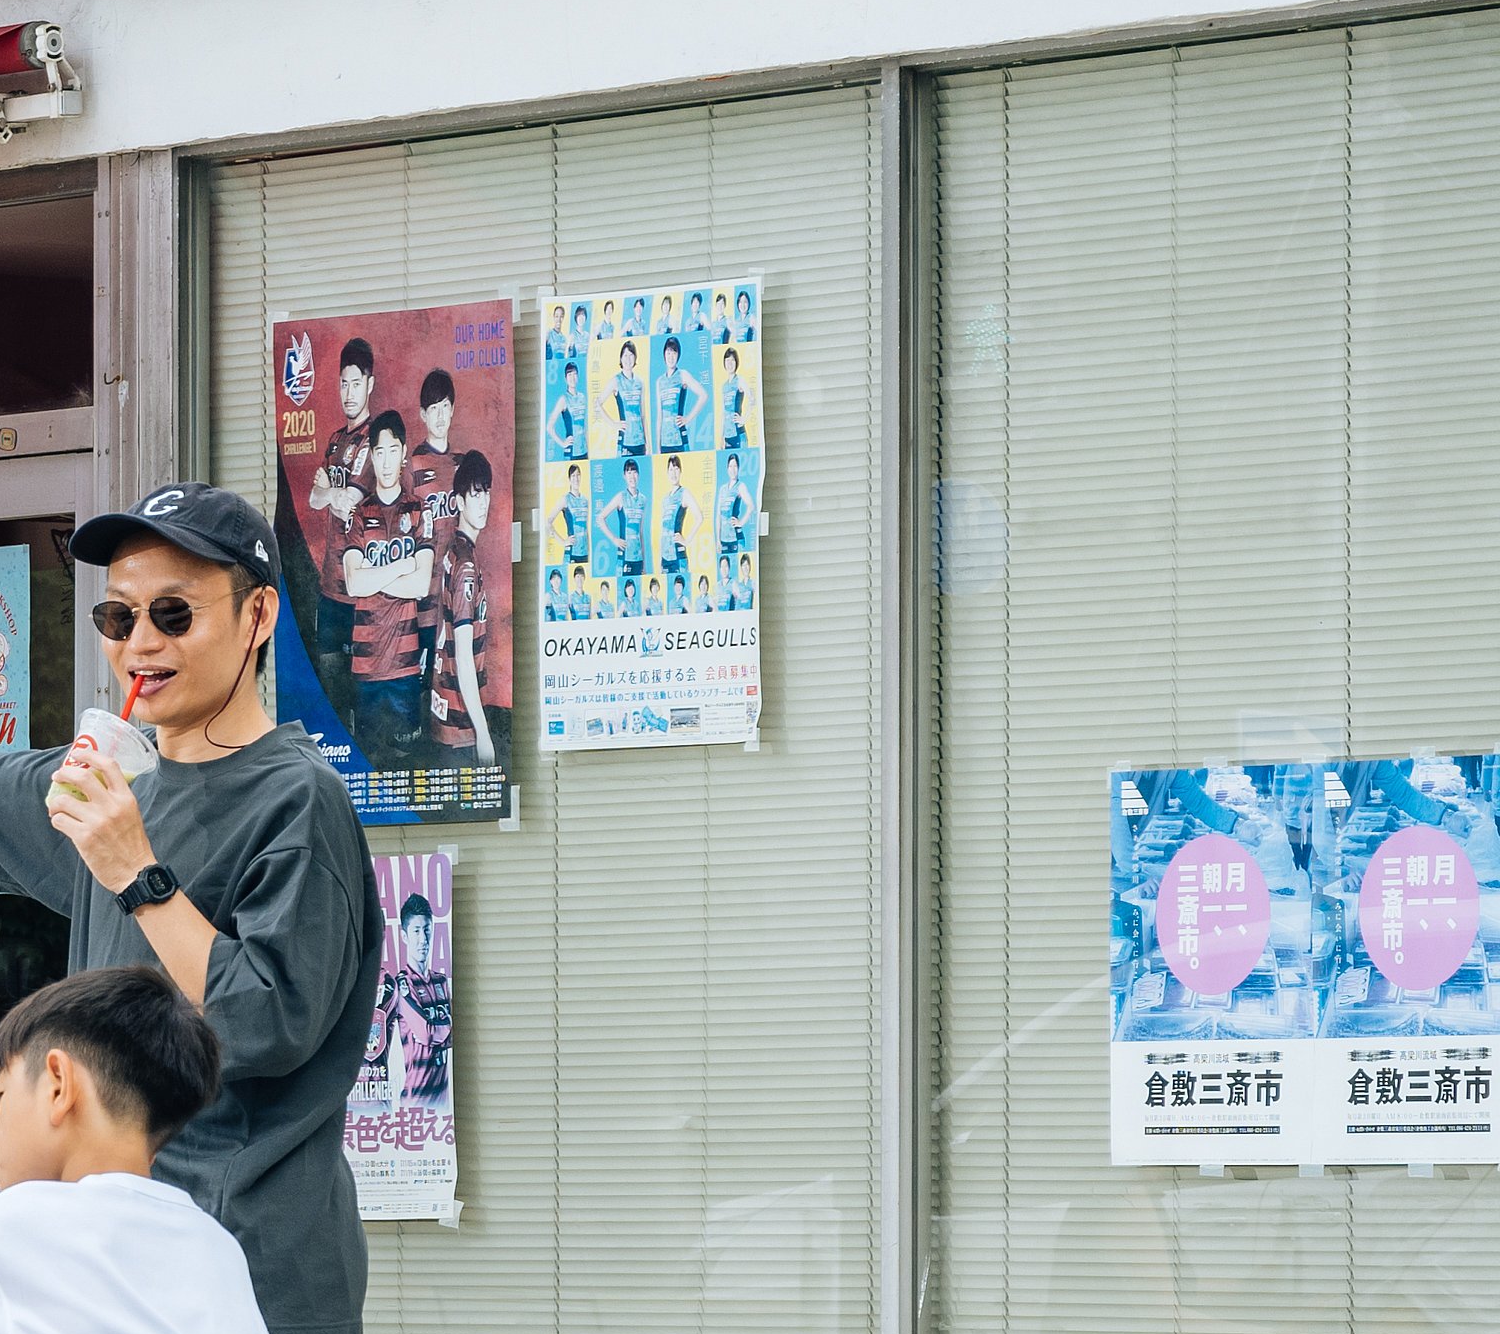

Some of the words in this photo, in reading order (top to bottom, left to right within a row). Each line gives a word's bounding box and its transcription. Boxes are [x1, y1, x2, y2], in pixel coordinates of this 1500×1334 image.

[455, 324, 474, 344] OUR
[478, 319, 506, 341] HOME
[455, 350, 474, 370] OUR
[478, 344, 506, 367] CLUB
[283, 410, 316, 438] 2020
[426, 490, 460, 519] GRO
[366, 536, 416, 567] GROP
[544, 634, 637, 658] OKAYAMA
[664, 626, 757, 651] SEAGULLS
[544, 666, 697, 689] 岡山シーガルズを応援する会
[705, 664, 758, 681] 会員募集中
[1177, 864, 1199, 970] 三斎市。
[1381, 857, 1404, 964] 三斎市。
[1144, 1069, 1284, 1107] 倉敷三斎市
[1347, 1066, 1493, 1105] 倉敷三斎市
